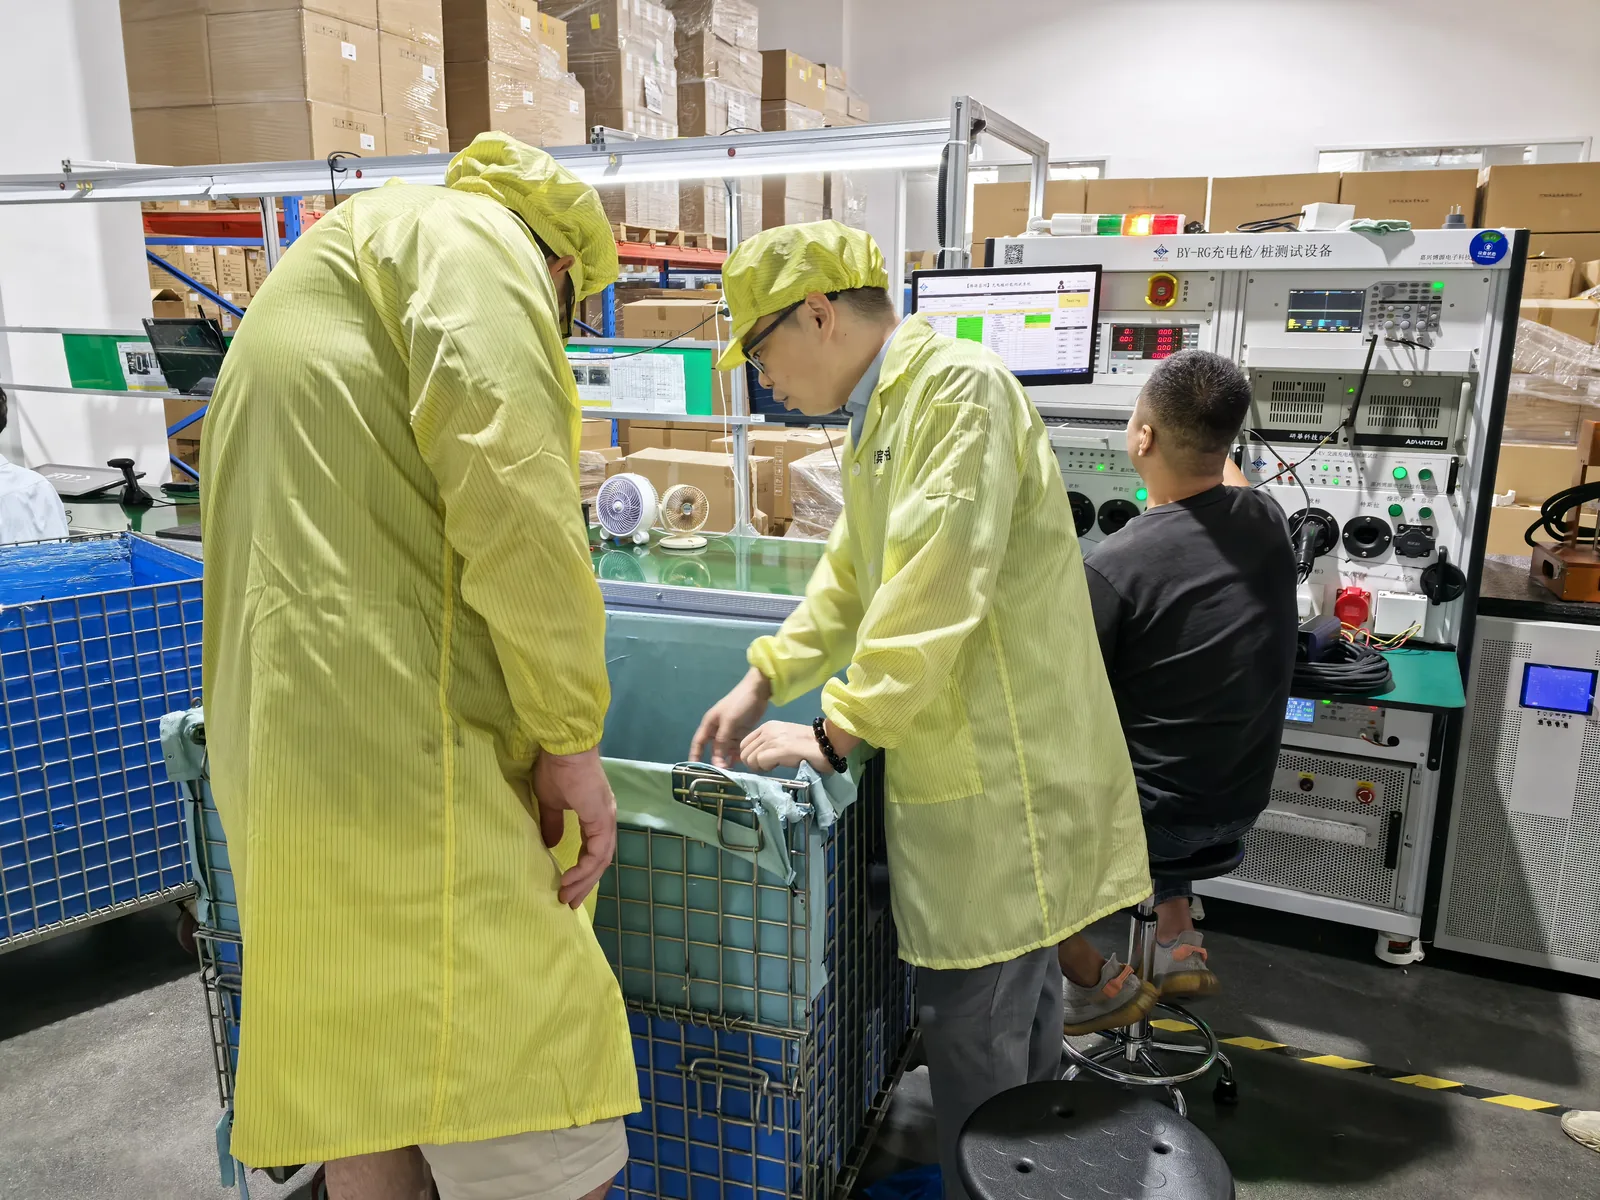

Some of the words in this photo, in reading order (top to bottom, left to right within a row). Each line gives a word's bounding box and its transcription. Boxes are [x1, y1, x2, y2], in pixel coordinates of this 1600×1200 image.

[1177, 242, 1333, 260] BY-RG充电枪/桩测试设备
[1405, 438, 1444, 446] ADVANTECH
